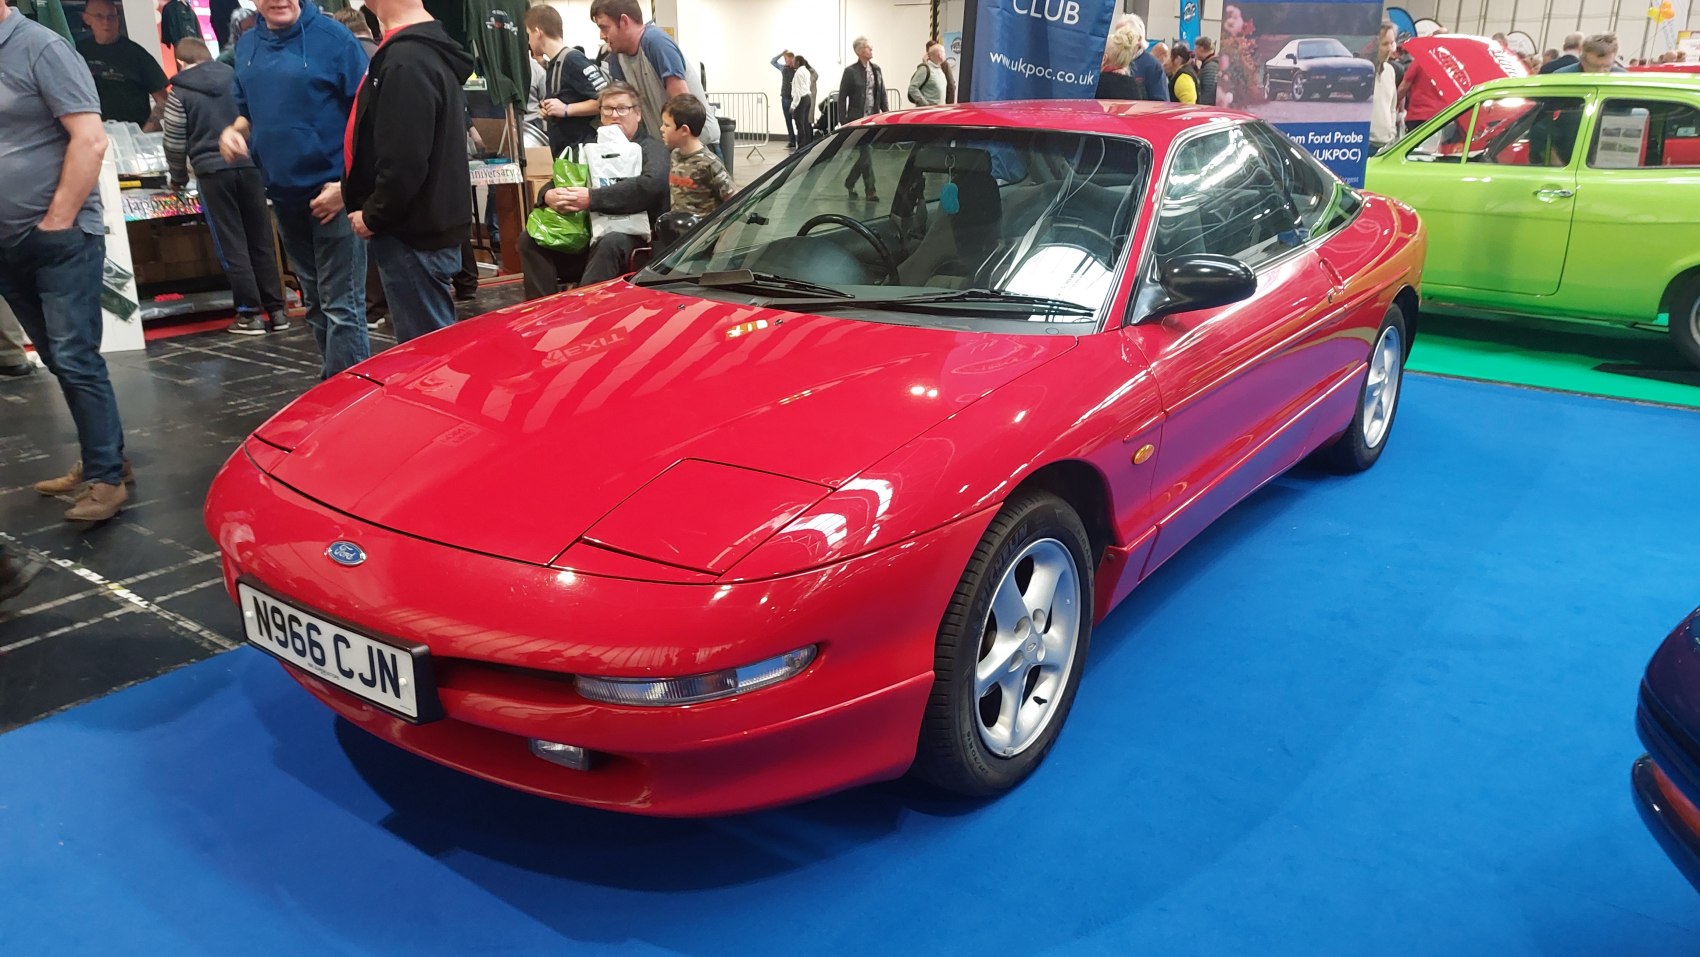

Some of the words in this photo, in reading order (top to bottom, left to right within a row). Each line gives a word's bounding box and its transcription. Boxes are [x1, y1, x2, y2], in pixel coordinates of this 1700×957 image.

[1013, 0, 1080, 25] CLUB
[989, 52, 1095, 86] www.ukpoc.co.uk
[1308, 132, 1332, 144] Ford
[1334, 131, 1363, 144] Probe
[1313, 148, 1362, 163] (UKPOC)
[252, 595, 326, 667] N966
[332, 633, 401, 700] CJN
